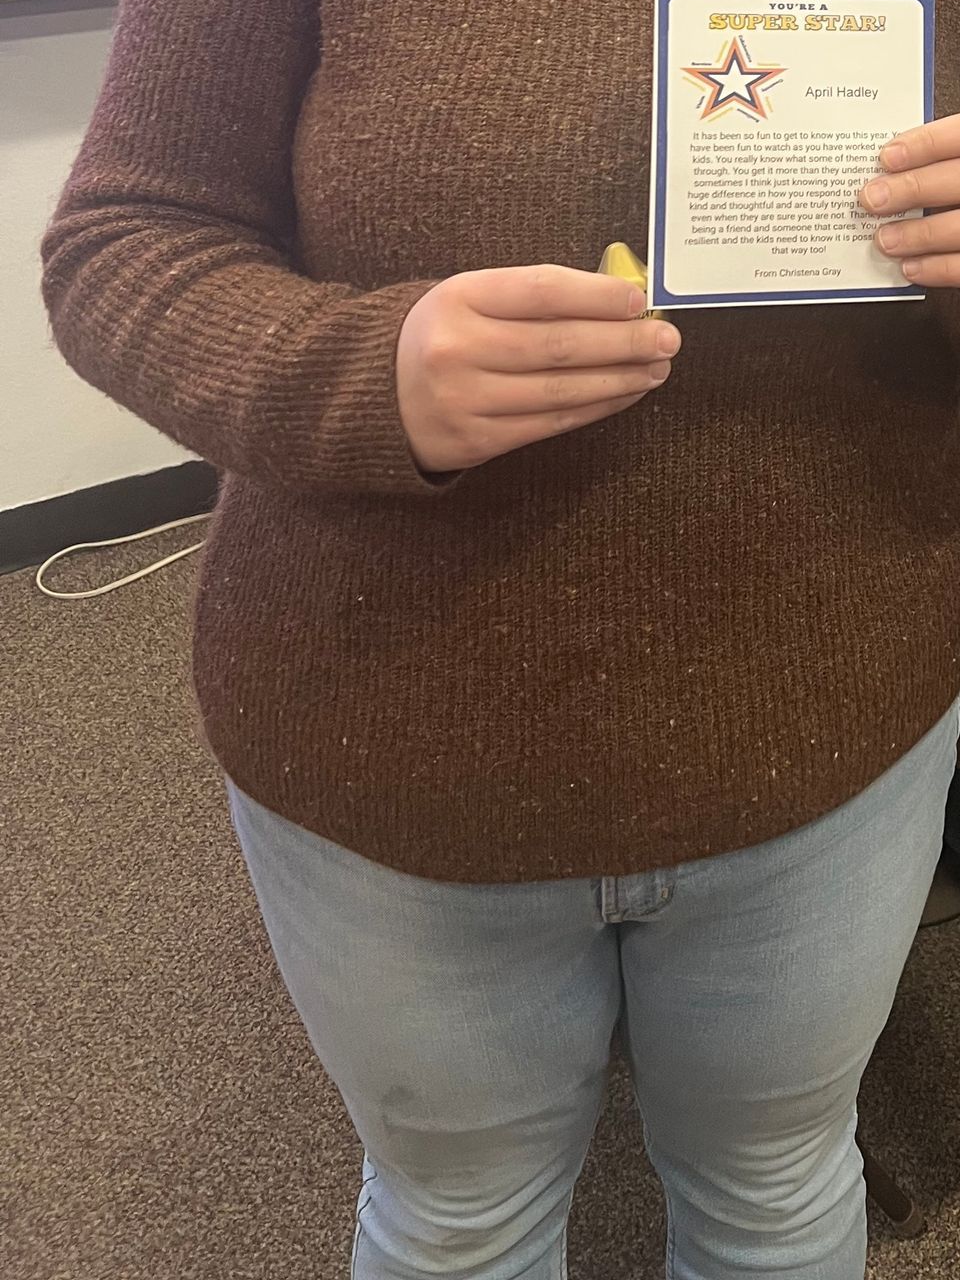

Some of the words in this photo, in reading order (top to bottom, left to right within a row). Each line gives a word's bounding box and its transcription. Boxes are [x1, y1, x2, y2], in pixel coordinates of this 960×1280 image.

[709, 13, 799, 31] SUPER
[805, 15, 886, 32] STAR!
[805, 87, 833, 100] April
[837, 86, 879, 100] Hadley
[702, 132, 717, 140] has
[720, 132, 741, 140] been
[757, 132, 771, 140] fun
[773, 132, 782, 140] to
[784, 132, 798, 141] get
[800, 132, 809, 140] to
[836, 133, 851, 141] you
[690, 144, 711, 152] have
[714, 144, 735, 152] been
[738, 143, 752, 151] fun
[806, 145, 820, 153] you
[823, 143, 843, 151] have
[845, 143, 876, 151] worked
[716, 156, 733, 164] You
[735, 155, 758, 165] really
[760, 155, 783, 163] know
[786, 155, 807, 163] what
[835, 154, 844, 162] of
[733, 167, 749, 175] You
[752, 168, 766, 177] get
[822, 167, 840, 176] they
[694, 179, 743, 188] sometimes
[751, 179, 772, 187] think
[774, 178, 790, 188] just
[792, 179, 828, 188] knowing
[830, 180, 846, 188] you
[848, 178, 861, 187] get
[688, 191, 710, 200] huge
[712, 190, 756, 199] difference
[768, 190, 786, 198] how
[789, 191, 804, 199] you
[806, 189, 841, 200] respond
[689, 202, 708, 210] kind
[710, 202, 727, 210] and
[729, 201, 774, 211] thoughtful
[776, 201, 792, 209] and
[810, 200, 829, 210] truly
[831, 200, 855, 209] trying
[714, 214, 738, 222] when
[740, 214, 759, 223] they
[798, 213, 814, 222] you
[692, 225, 716, 235] being
[726, 224, 752, 233] friend
[754, 224, 771, 232] and
[815, 223, 831, 231] that
[861, 222, 877, 230] You
[685, 237, 720, 245] resilient
[722, 236, 739, 245] and
[740, 236, 755, 244] the
[757, 235, 775, 244] kids
[777, 235, 798, 243] need
[800, 235, 809, 243] to
[810, 234, 833, 242] know
[835, 234, 841, 242] it
[772, 246, 789, 255] that
[791, 247, 808, 255] way
[810, 246, 827, 254] too!
[755, 269, 777, 278] From
[779, 268, 820, 278] Christena
[822, 268, 842, 277] Gray
